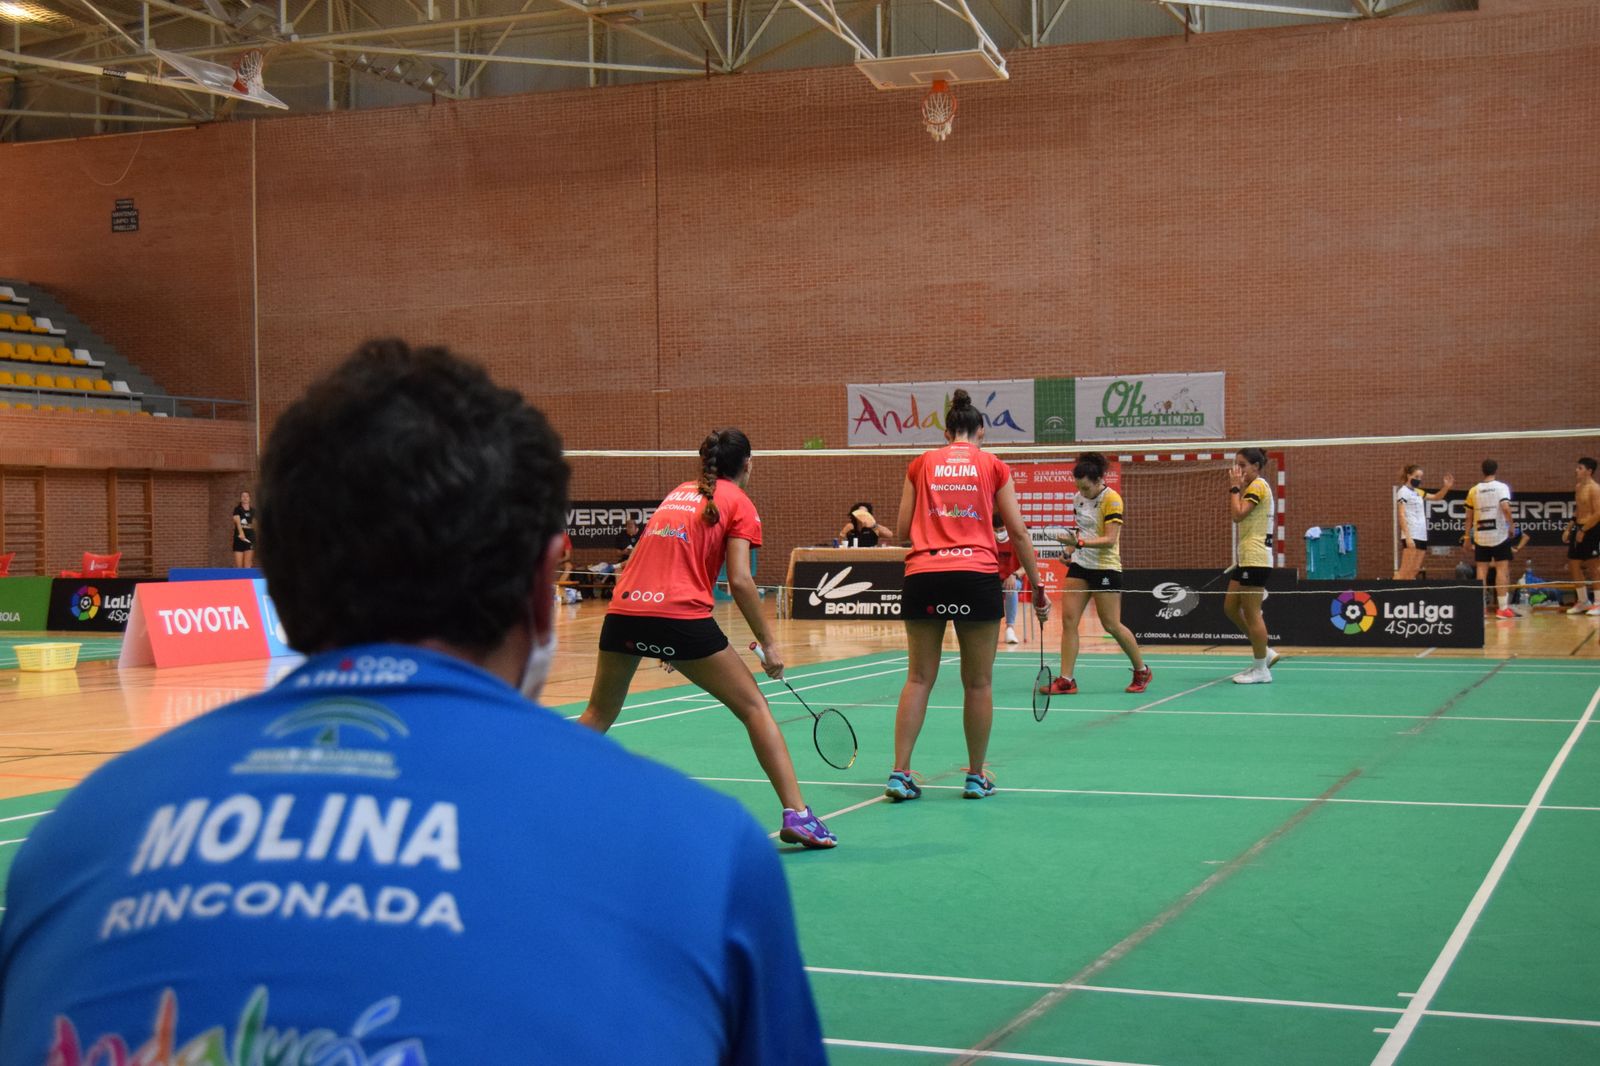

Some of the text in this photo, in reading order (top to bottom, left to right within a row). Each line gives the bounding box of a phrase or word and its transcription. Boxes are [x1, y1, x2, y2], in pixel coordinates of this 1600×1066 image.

[1102, 381, 1152, 417] Ok
[1099, 414, 1201, 426] AL JUEGO LIMPIO
[935, 465, 978, 477] MOLINA
[931, 483, 978, 492] RINCONADA
[104, 594, 131, 609] LaLi
[825, 601, 901, 615] BADMINTO
[158, 606, 249, 635] TOYOTA
[1384, 600, 1454, 623] LaLiga
[1385, 620, 1453, 638] 4Sports
[130, 793, 461, 877] MOLINA
[100, 882, 464, 942] RINCONADA
